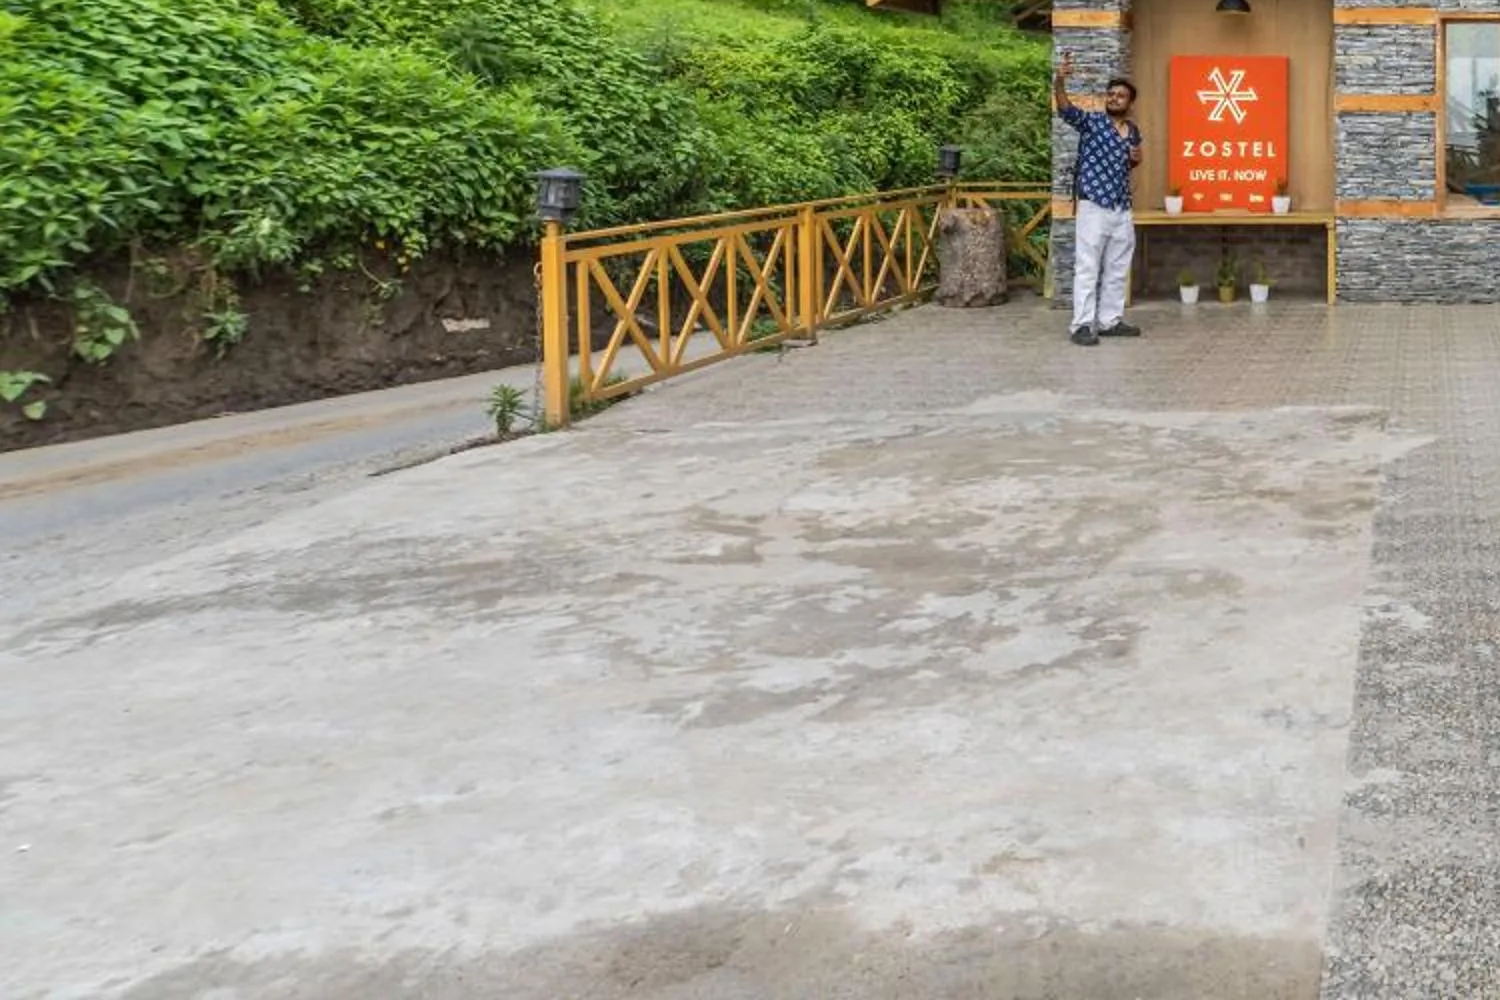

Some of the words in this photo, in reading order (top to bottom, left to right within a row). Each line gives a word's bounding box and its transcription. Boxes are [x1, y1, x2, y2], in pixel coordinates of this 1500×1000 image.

[1183, 141, 1276, 157] ZOSTEL
[1189, 169, 1214, 181] LIVE
[1217, 169, 1231, 181] IT.
[1234, 169, 1267, 181] NOW
